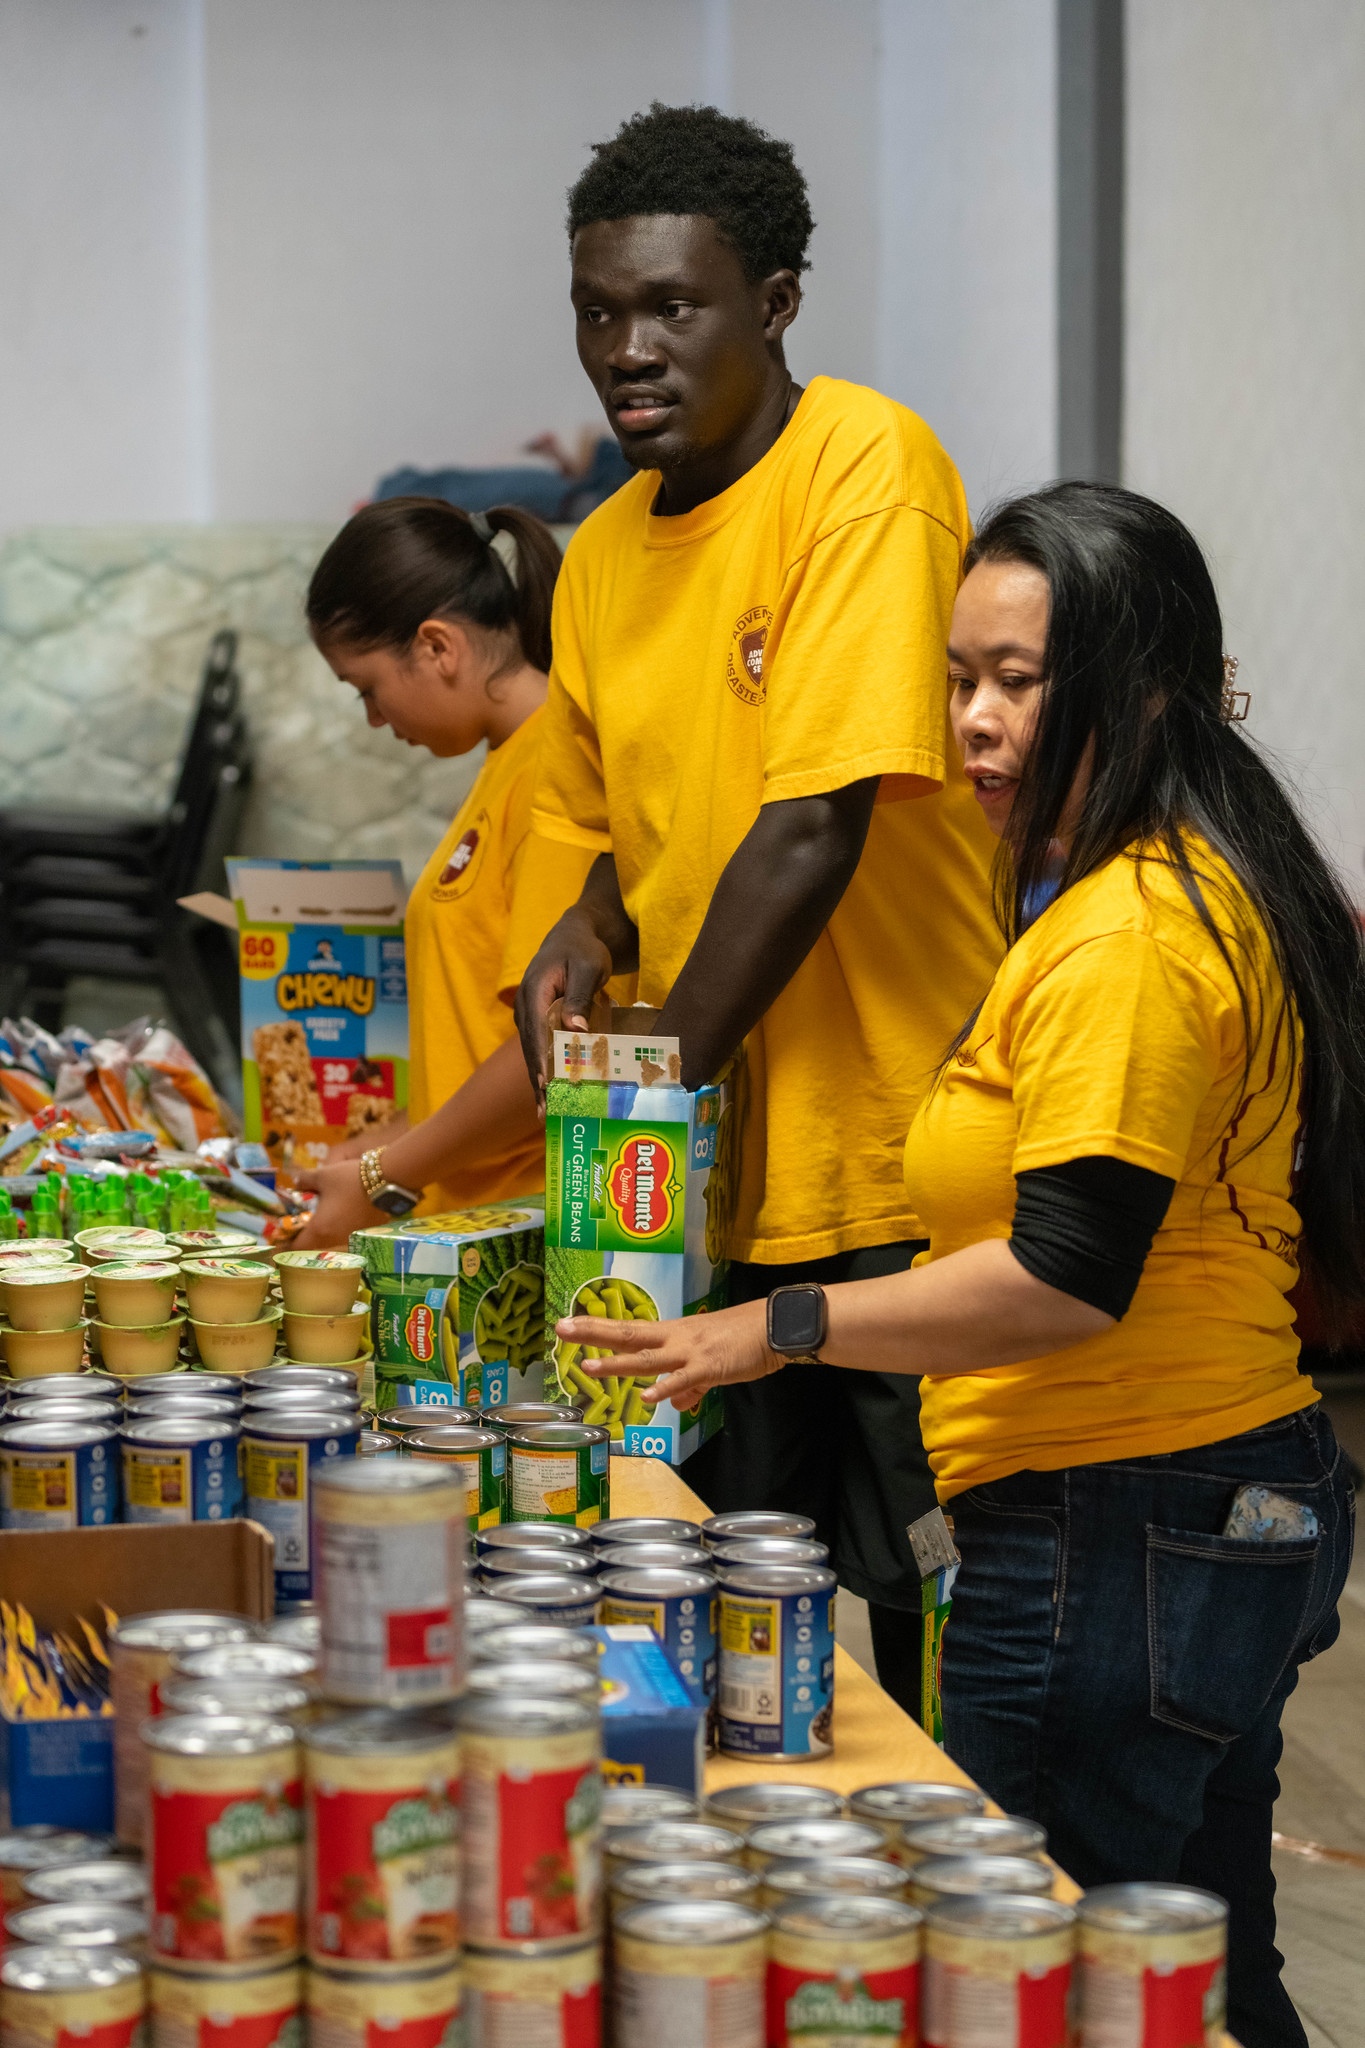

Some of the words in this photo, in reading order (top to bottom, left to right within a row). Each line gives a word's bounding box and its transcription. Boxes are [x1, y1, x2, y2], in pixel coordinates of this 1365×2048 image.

[244, 936, 275, 956] 60
[573, 1124, 585, 1152] CUT
[695, 1138, 709, 1158] 8
[636, 1142, 656, 1172] Del
[572, 1154, 585, 1197] GREEN
[593, 1162, 604, 1185] Fresh
[618, 1168, 632, 1204] Quality
[593, 1184, 604, 1205] Cut
[635, 1172, 655, 1231] Monte
[570, 1201, 583, 1243] BEANS
[378, 1299, 387, 1328] GREEN
[417, 1308, 427, 1325] Del
[417, 1325, 426, 1358] Monte
[487, 1366, 505, 1378] CANS
[489, 1379, 503, 1404] 8
[642, 1436, 666, 1456] 8
